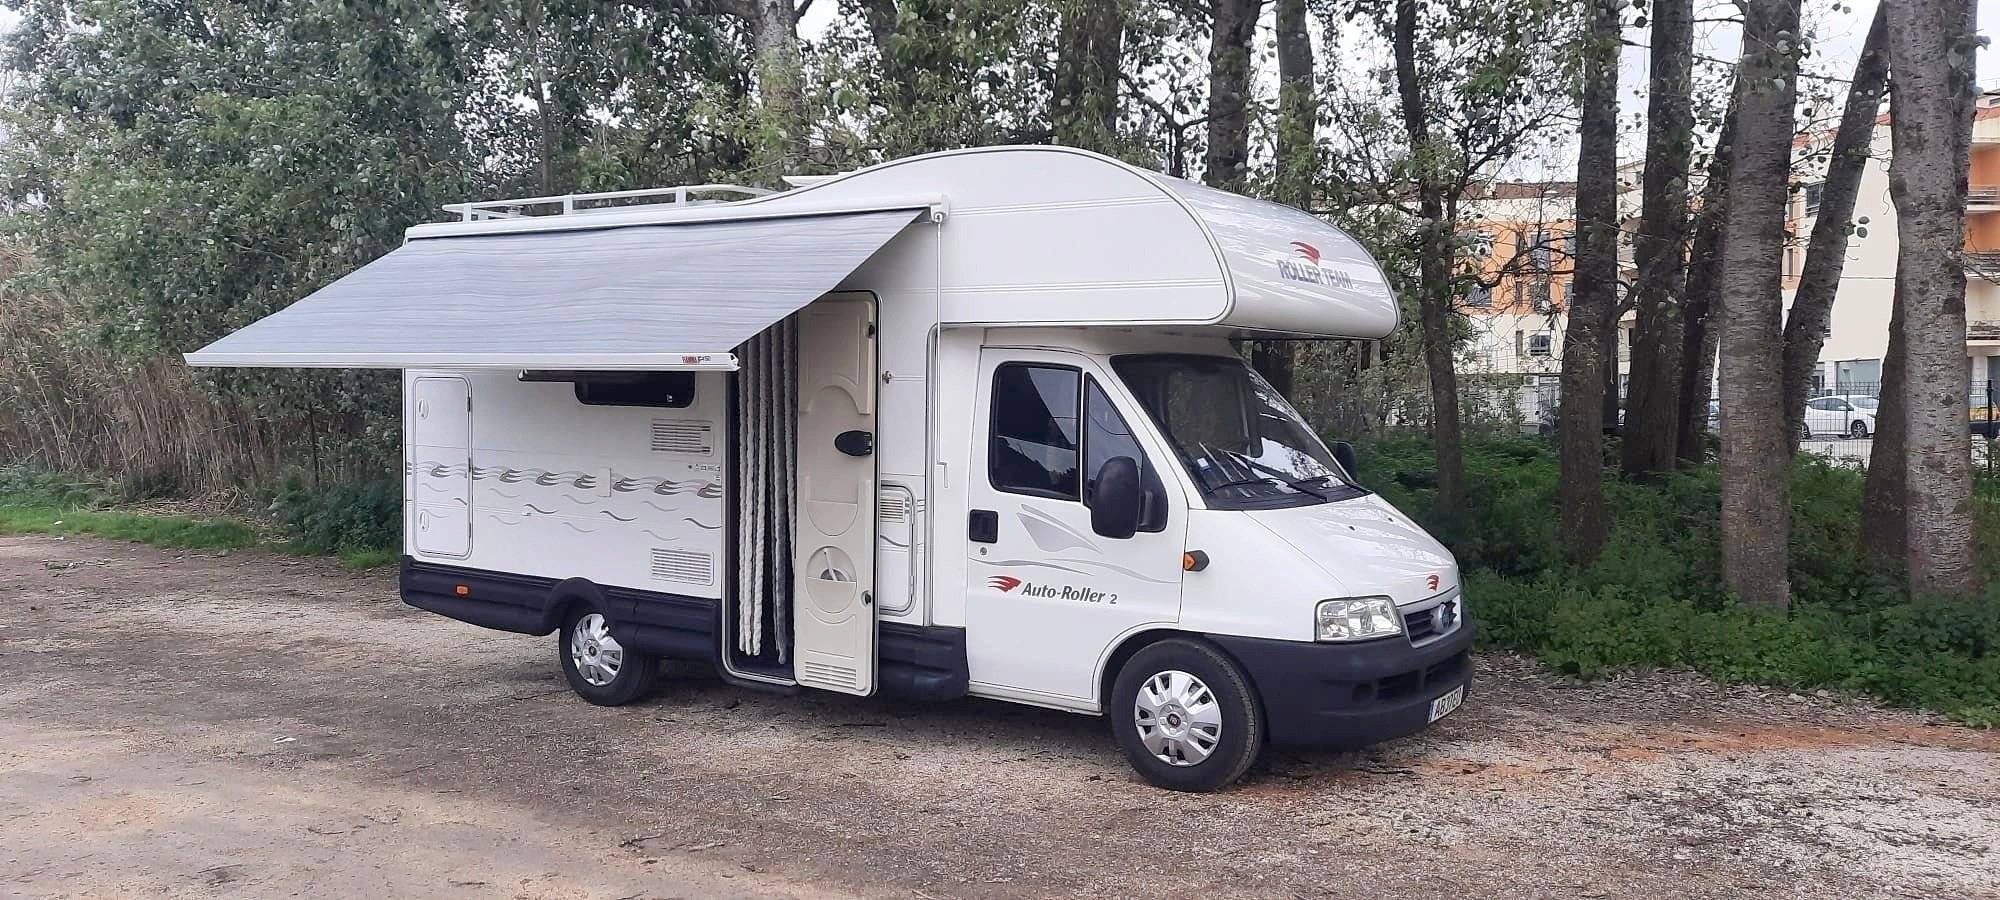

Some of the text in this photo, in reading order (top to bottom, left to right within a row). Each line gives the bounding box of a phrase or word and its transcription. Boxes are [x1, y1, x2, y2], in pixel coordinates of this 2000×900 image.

[1277, 259, 1353, 289] ROLLER TEAM
[1021, 582, 1118, 605] Auto-Roller 2
